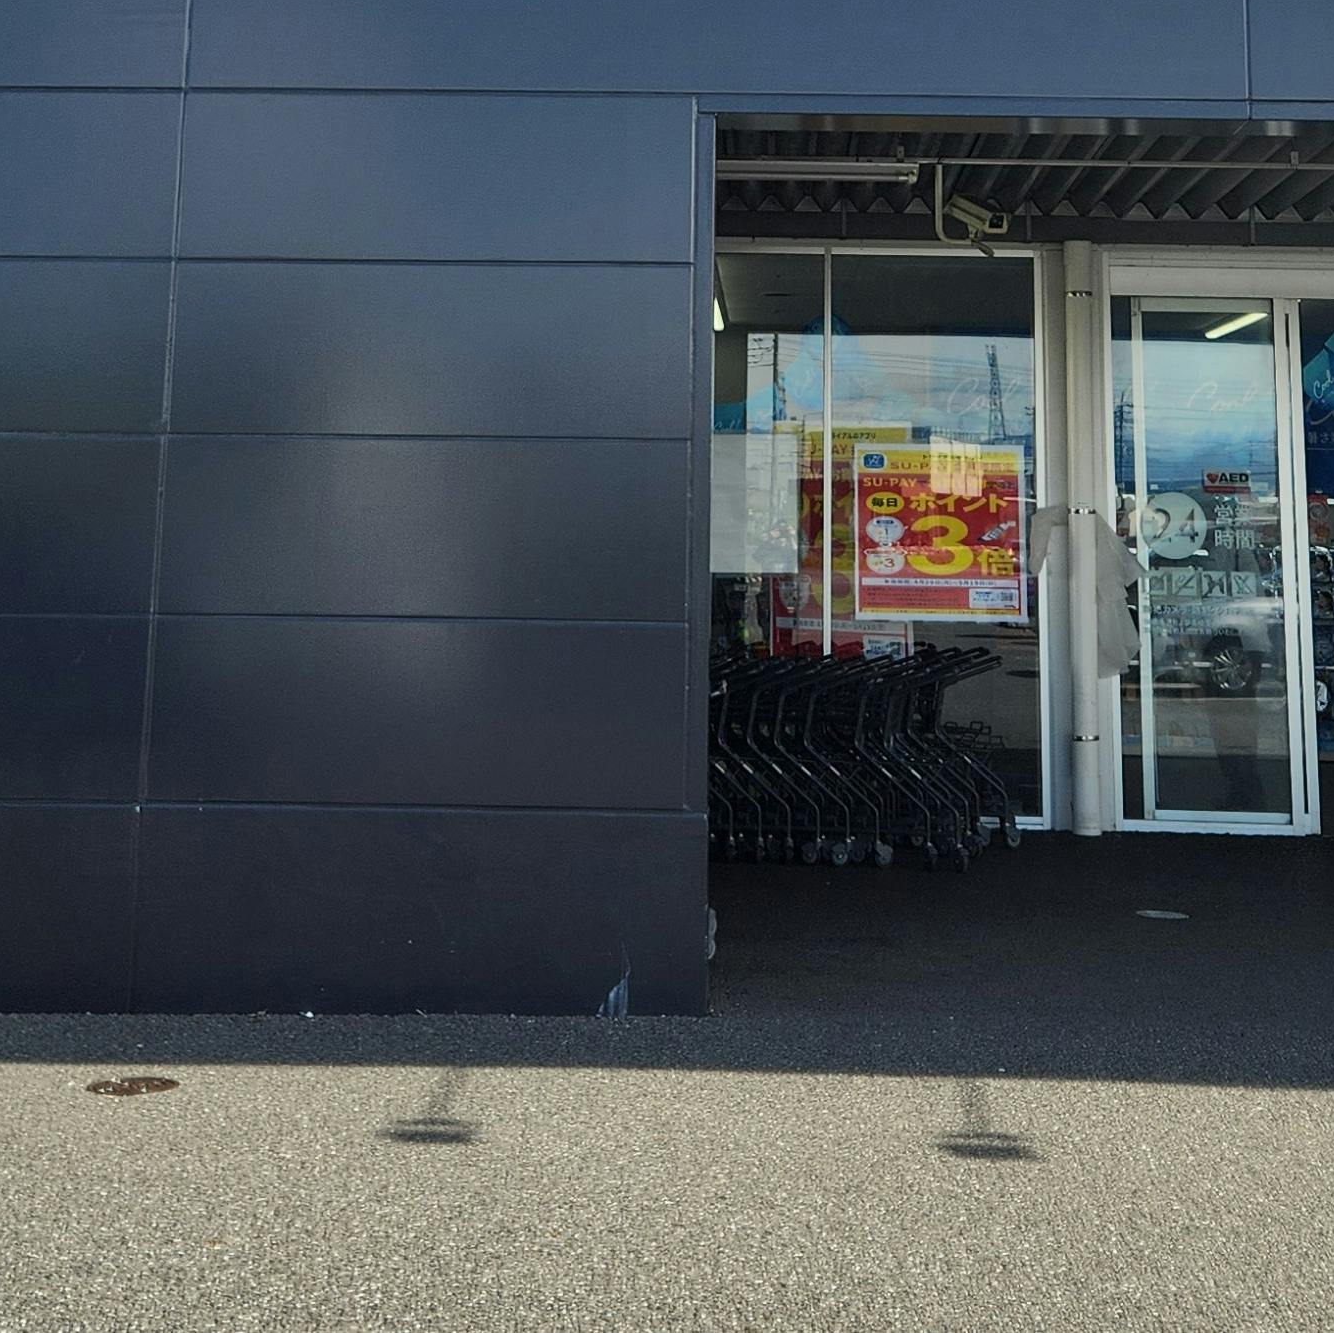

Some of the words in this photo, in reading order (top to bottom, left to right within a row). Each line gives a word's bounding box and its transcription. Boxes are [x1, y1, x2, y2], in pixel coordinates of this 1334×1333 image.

[862, 476, 917, 487] SU-PAY
[1218, 472, 1249, 484] AED
[871, 496, 898, 508] 毎日
[909, 492, 1009, 513] ポイント
[1214, 529, 1255, 550] 時間
